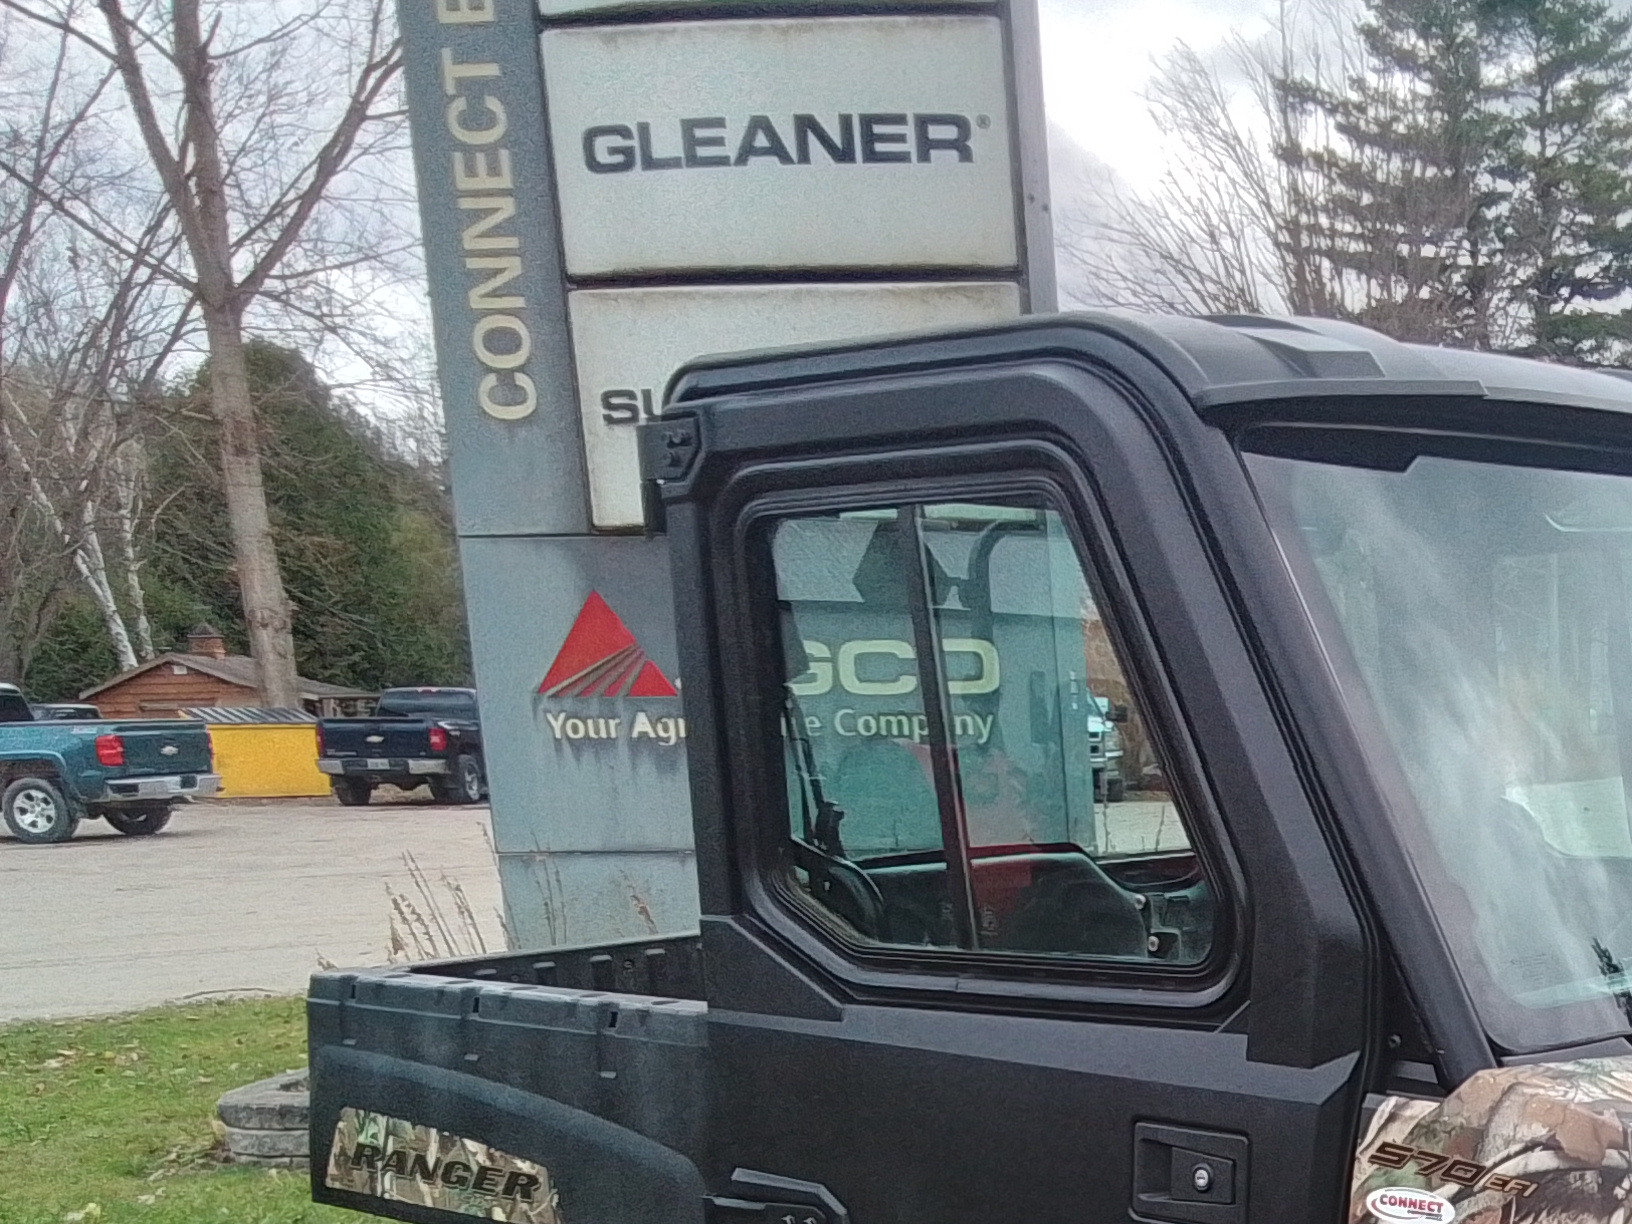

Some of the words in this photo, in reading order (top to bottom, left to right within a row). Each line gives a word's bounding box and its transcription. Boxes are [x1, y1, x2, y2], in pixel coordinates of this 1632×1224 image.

[441, 47, 538, 423] CONNECT
[546, 711, 621, 740] Your
[834, 708, 994, 745] Compny
[350, 1142, 542, 1203] RANGER
[1367, 1141, 1487, 1187] 570
[1485, 1174, 1539, 1198] EFI
[1379, 1193, 1444, 1214] CONNECT
